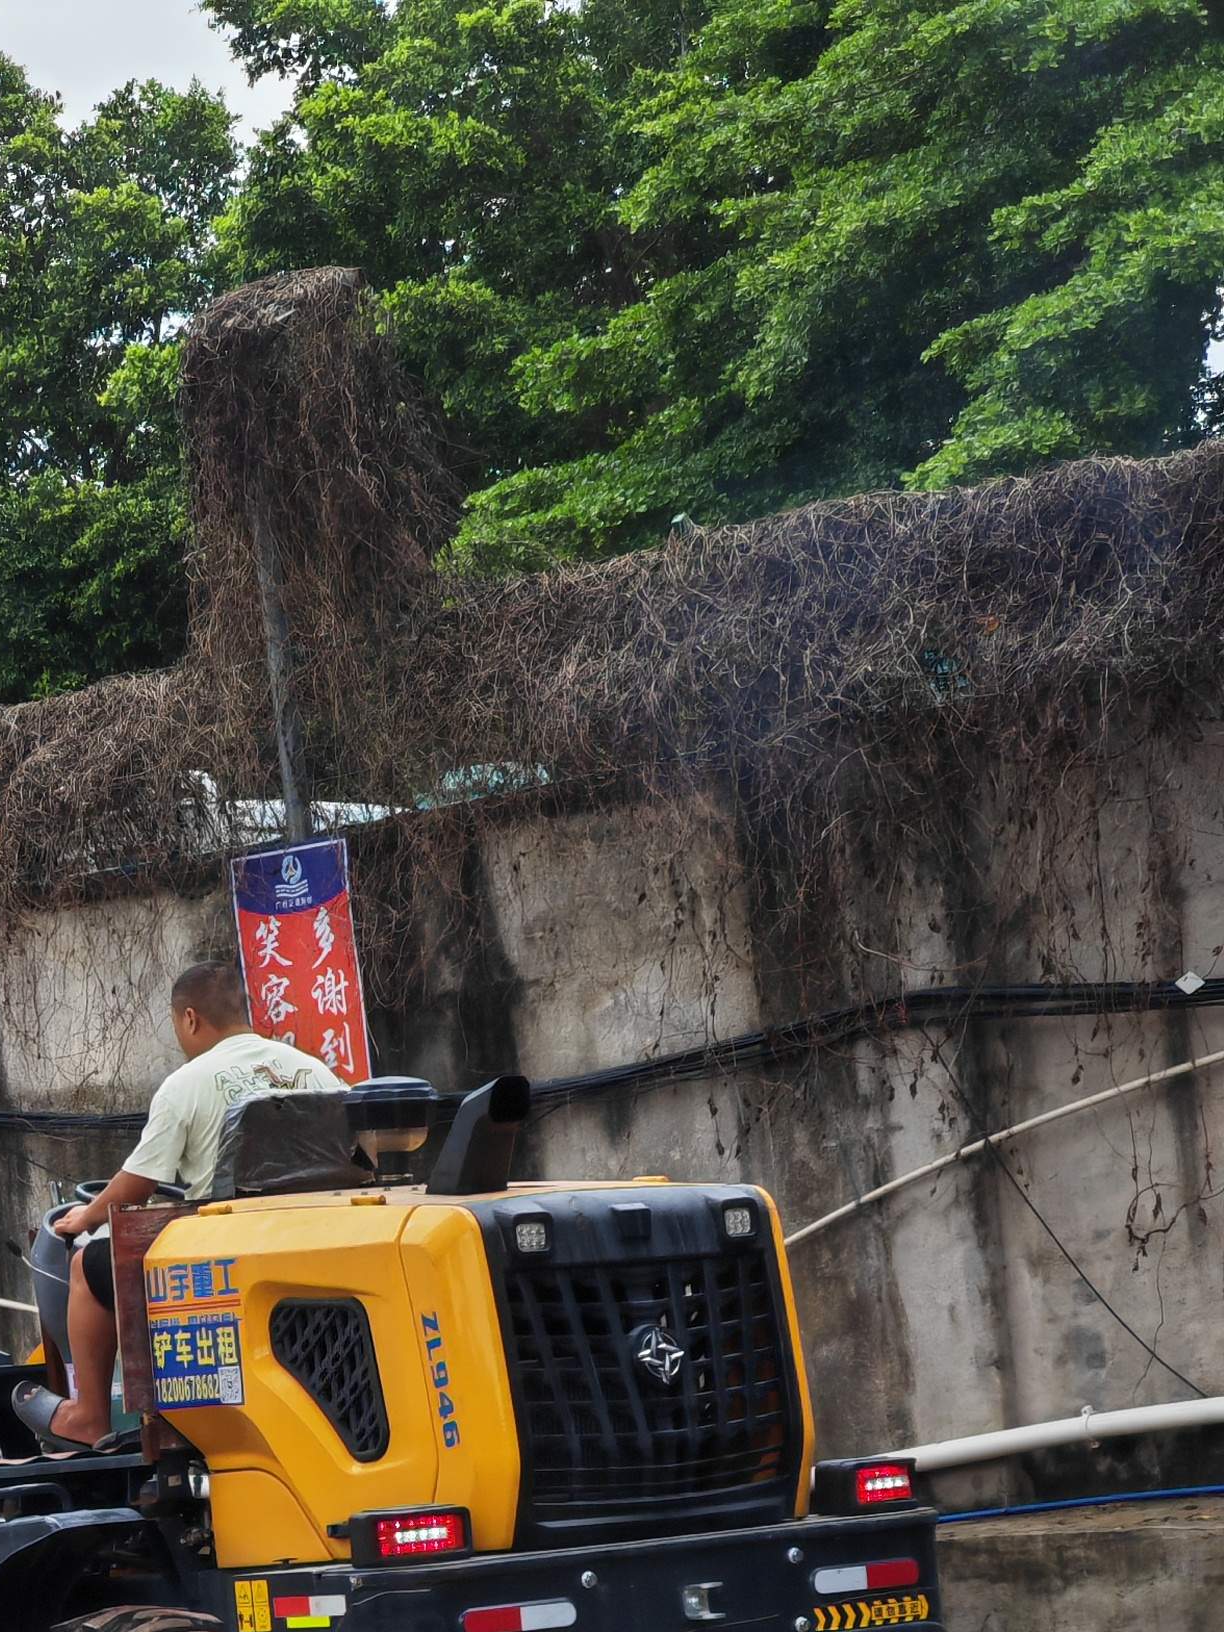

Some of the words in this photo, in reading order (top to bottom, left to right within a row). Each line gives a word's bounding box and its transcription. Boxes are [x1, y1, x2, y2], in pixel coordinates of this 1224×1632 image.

[153, 1326, 238, 1370] 铲车出租
[421, 1311, 461, 1449] ZL946
